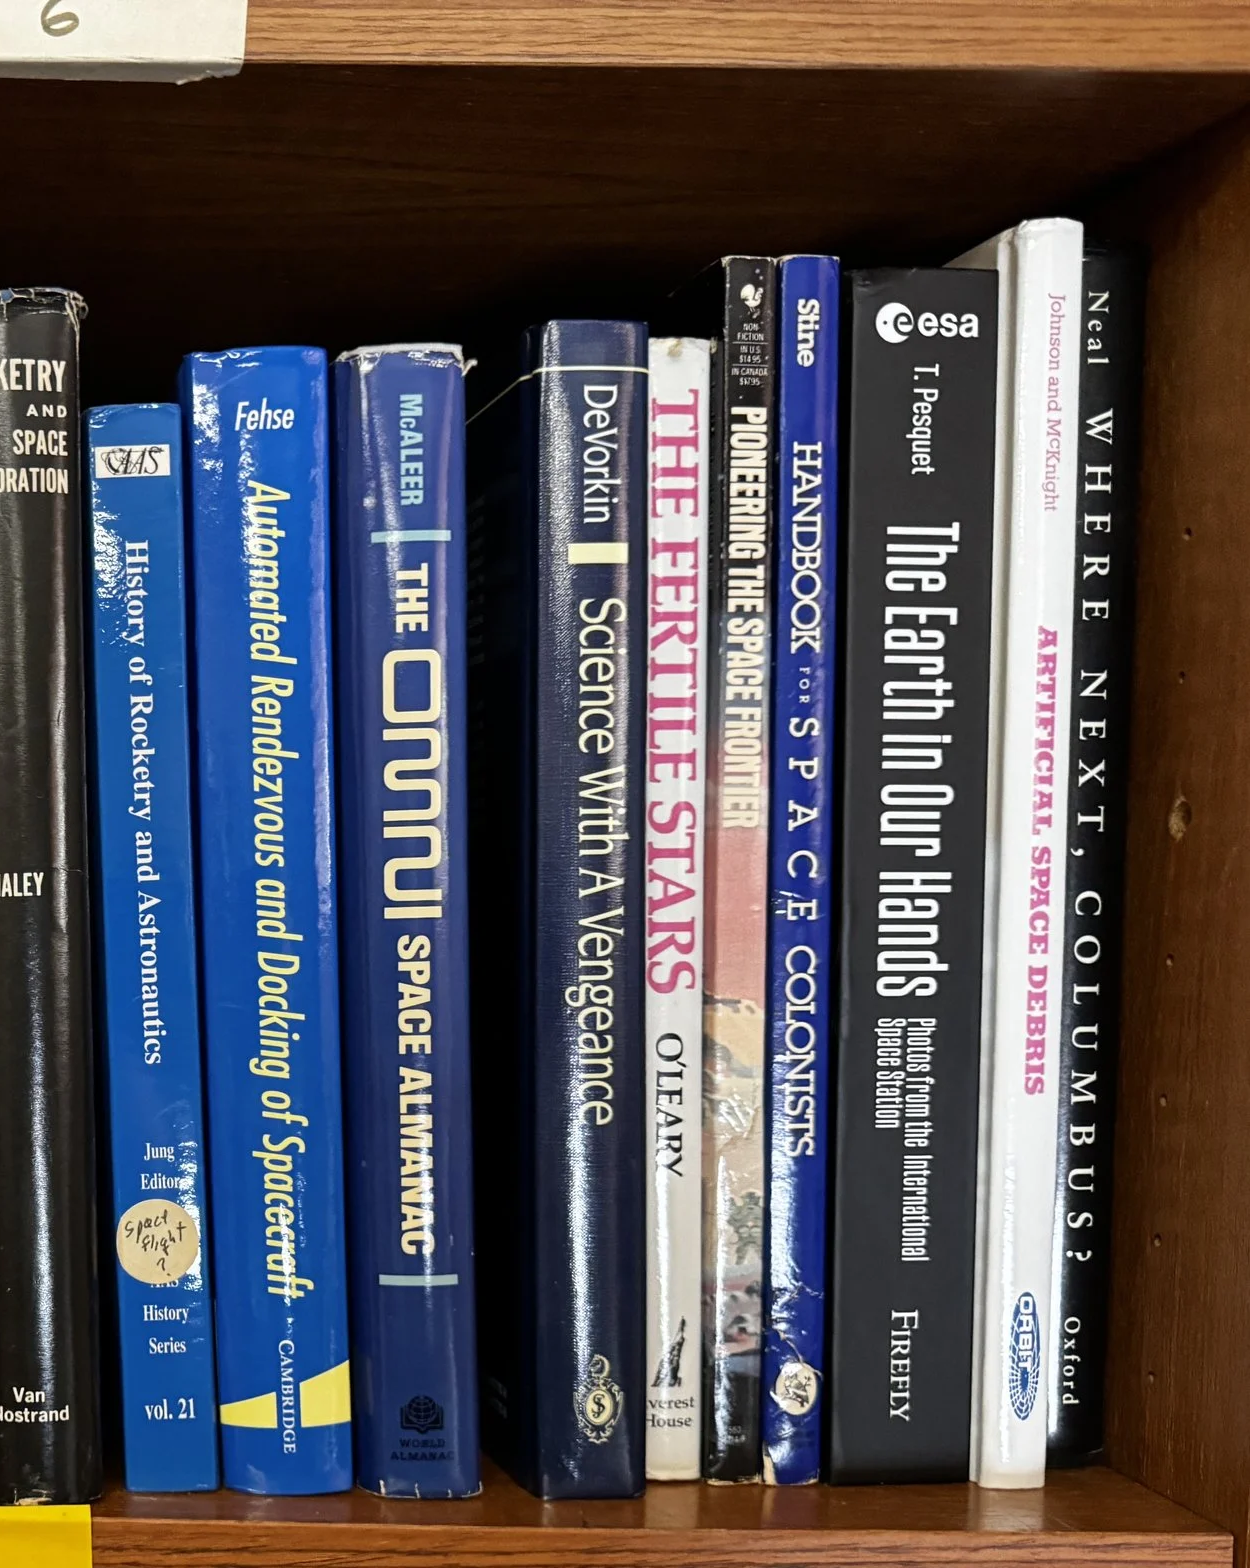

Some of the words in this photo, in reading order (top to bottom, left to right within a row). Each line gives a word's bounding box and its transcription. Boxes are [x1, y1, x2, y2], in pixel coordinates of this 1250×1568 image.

[737, 332, 764, 341] FICTION
[741, 368, 768, 376] CANADA
[797, 298, 819, 367] Stine
[914, 363, 939, 380] T.
[1048, 293, 1066, 371] Johnson
[1087, 291, 1109, 365] Neal
[27, 404, 67, 418] AND
[235, 398, 295, 431] Fehse
[906, 388, 939, 475] Pesquet
[1047, 376, 1062, 412] and
[12, 429, 68, 457] SPACE
[400, 394, 424, 506] McALEER
[583, 385, 622, 524] DeVorkin
[651, 389, 699, 517] THE
[728, 407, 767, 559] PIONEERING
[1041, 418, 1061, 512] McKnight
[790, 441, 822, 654] HANDBOOK
[885, 521, 960, 592] The
[1082, 408, 1113, 621] WHERE
[122, 540, 149, 647] History
[247, 480, 297, 664] Automated
[396, 563, 428, 633] THE
[727, 564, 766, 613] THE
[129, 656, 153, 685] of
[578, 598, 627, 754] Science
[648, 537, 698, 783] FERTILE
[725, 617, 764, 700] SPACE
[799, 667, 810, 703] FOR
[882, 606, 958, 720] Earth
[128, 693, 155, 821] Rocketry
[251, 675, 299, 867] Rendezvous
[722, 707, 762, 829] FRONTIER
[881, 734, 952, 770] in
[1032, 625, 1058, 835] ARTIFICIAL
[1070, 669, 1107, 856] NEXT,
[578, 765, 629, 857] With
[787, 717, 820, 921] SPACE
[879, 784, 954, 857] Our
[135, 831, 160, 883] and
[579, 867, 624, 899] A
[646, 801, 697, 994] STARS
[1029, 846, 1050, 954] SPACE
[255, 878, 303, 941] and
[876, 871, 952, 997] Hands
[138, 891, 167, 1065] Astronautics
[250, 951, 305, 1079] Docking
[397, 935, 432, 1055] SPACE
[565, 906, 624, 1126] Vengeance
[785, 945, 817, 1156] COLONISTS
[874, 1018, 906, 1066] Space
[906, 1018, 937, 1072] Photos
[1023, 965, 1048, 1095] DEBRIS
[261, 1090, 308, 1126] of
[874, 1070, 905, 1129] Station
[904, 1076, 936, 1118] from
[1066, 890, 1102, 1261] COLUMBUS?
[144, 1143, 175, 1162] Jung
[399, 1066, 435, 1255] ALMANAC
[903, 1121, 934, 1149] the
[252, 1134, 314, 1299] Spacecraft
[901, 1155, 934, 1262] International
[143, 1305, 189, 1323] History
[149, 1338, 186, 1353] Series
[12, 1387, 45, 1403] Van
[279, 1340, 296, 1454] CAMBRIDGE
[889, 1309, 919, 1421] FIREFLY
[1062, 1317, 1081, 1405] Oxford
[145, 1401, 172, 1419] vol.
[178, 1398, 196, 1419] 21
